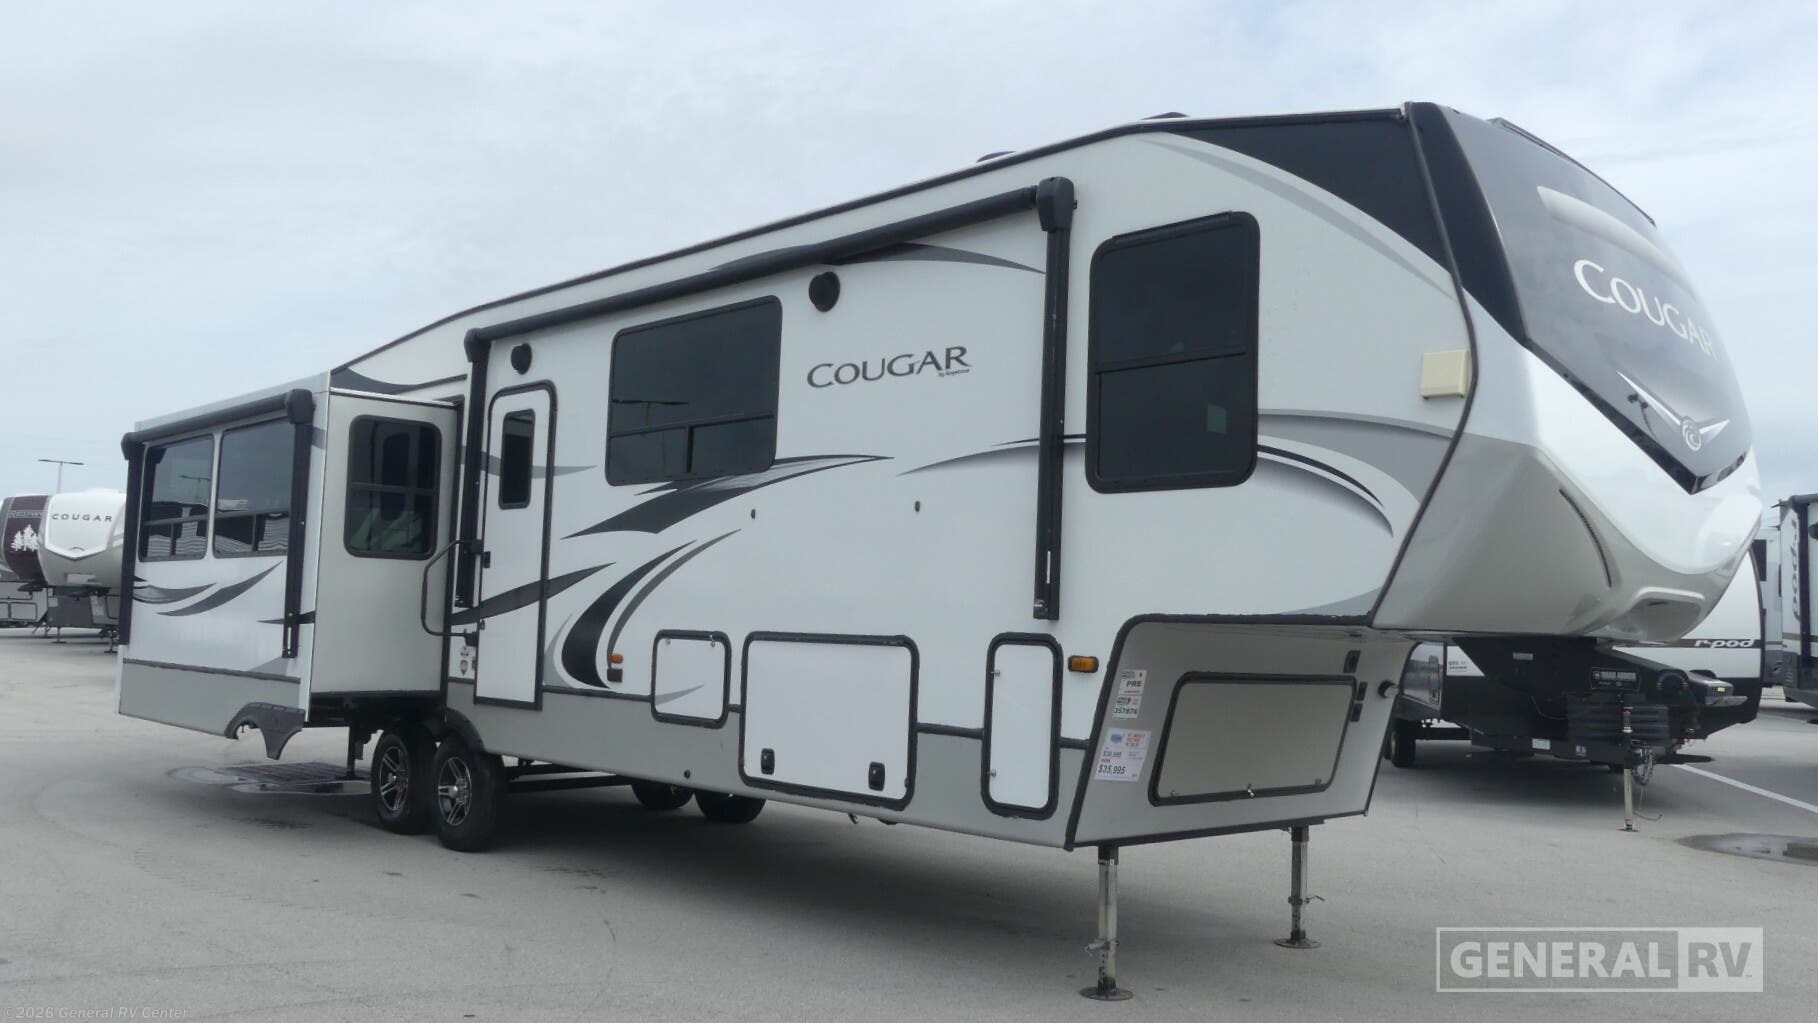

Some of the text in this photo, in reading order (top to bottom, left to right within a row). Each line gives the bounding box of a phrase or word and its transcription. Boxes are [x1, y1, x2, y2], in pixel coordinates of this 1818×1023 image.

[1573, 258, 1719, 360] COUGAR
[806, 345, 972, 388] COUGAR
[52, 513, 112, 522] COUGAR
[1694, 638, 1755, 649] r-pod
[1126, 680, 1143, 688] PRE
[1097, 764, 1126, 775] $35,995
